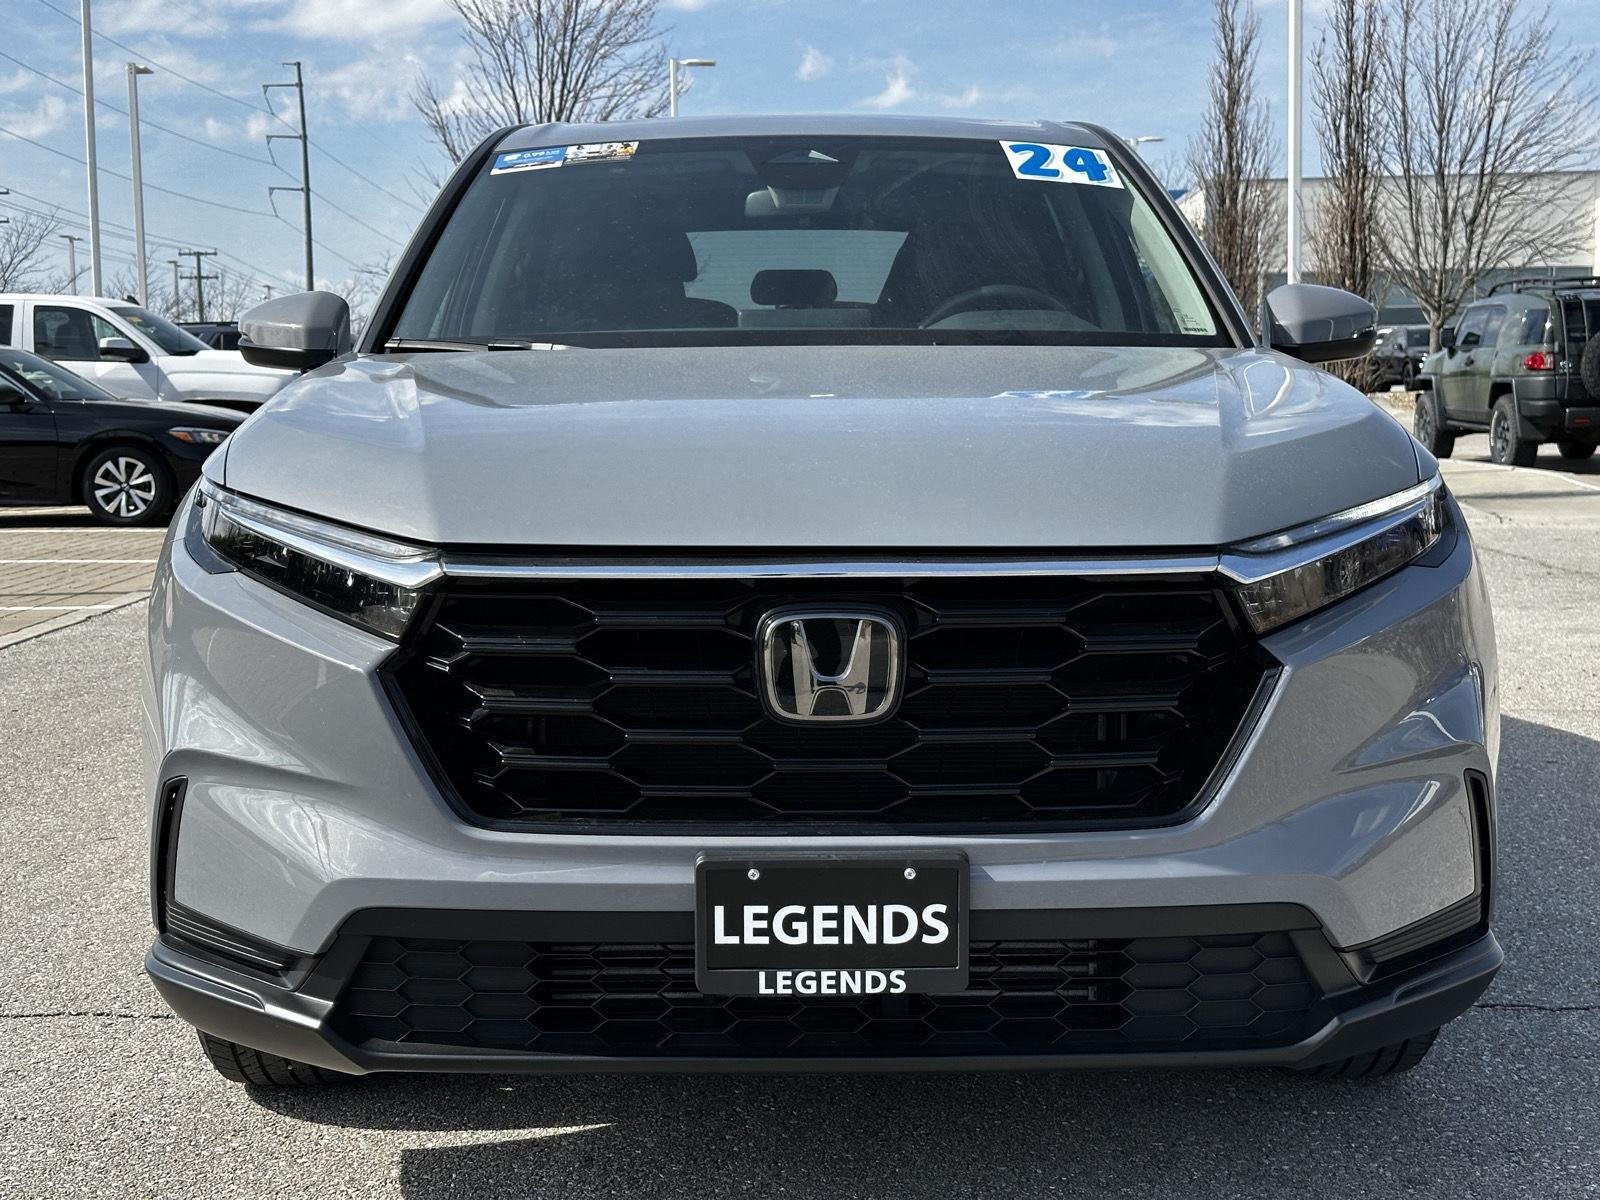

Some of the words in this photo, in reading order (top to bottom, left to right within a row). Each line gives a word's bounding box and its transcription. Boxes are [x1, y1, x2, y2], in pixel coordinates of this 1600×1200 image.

[1008, 144, 1108, 181] 24
[714, 903, 949, 945] LEGENDS
[758, 969, 907, 995] LEGENDS
